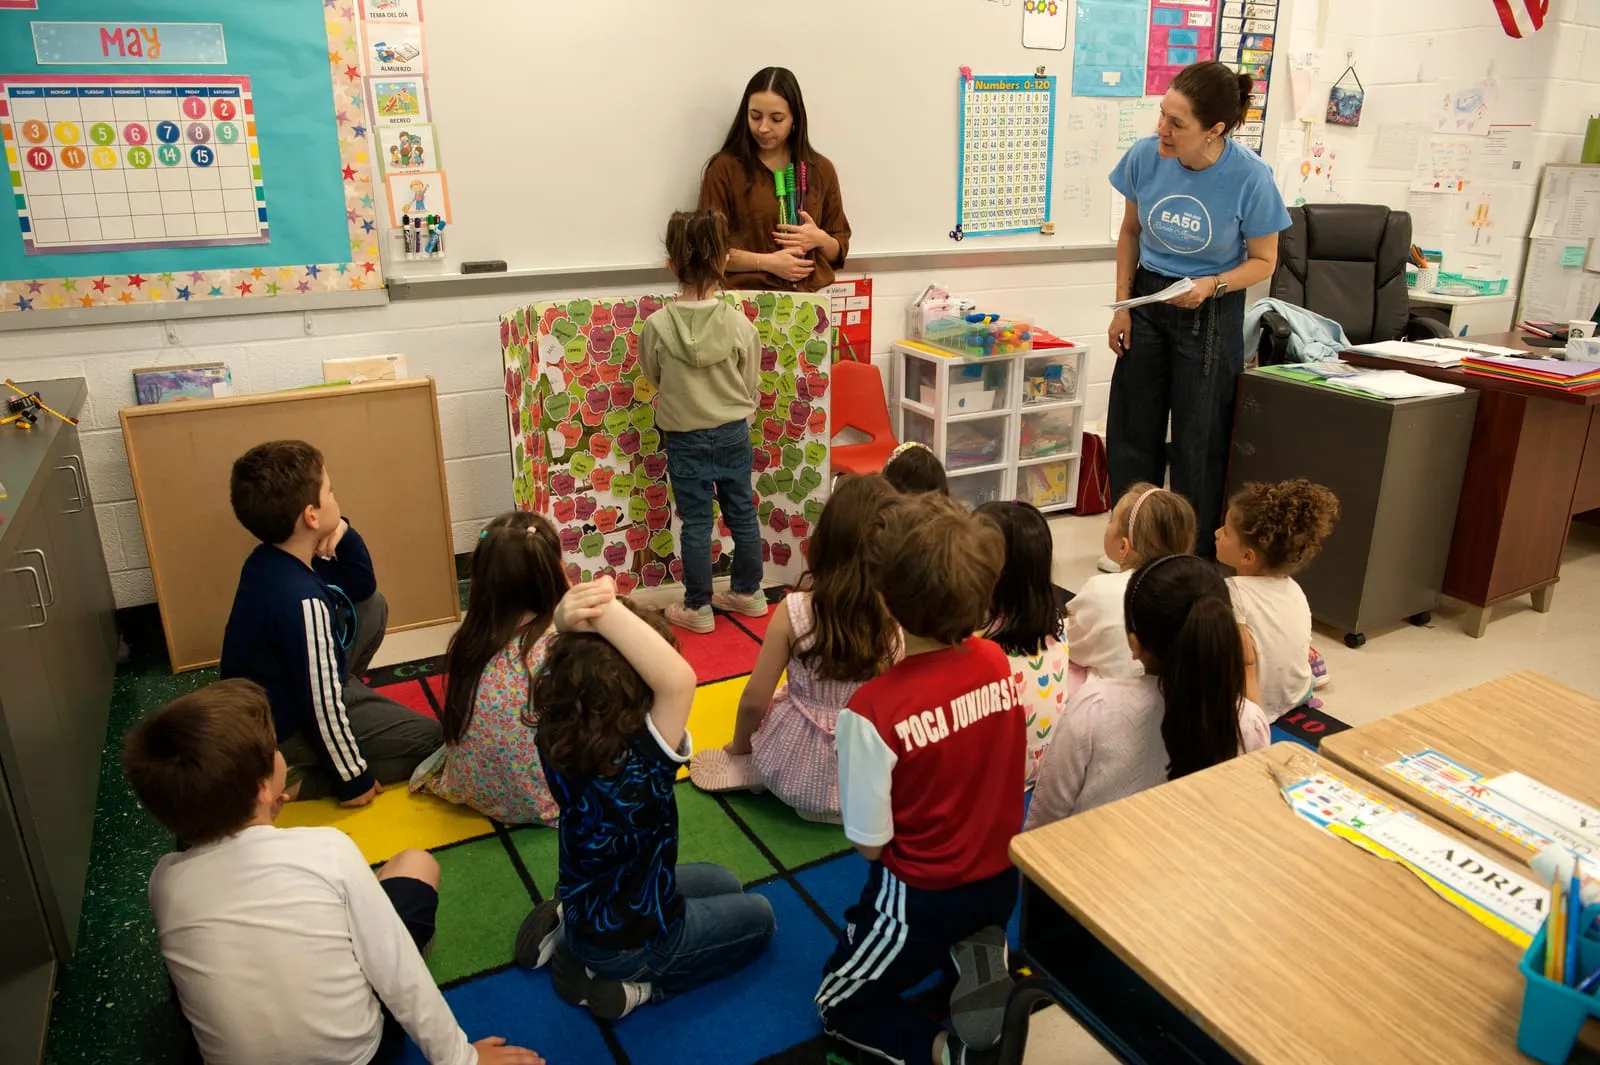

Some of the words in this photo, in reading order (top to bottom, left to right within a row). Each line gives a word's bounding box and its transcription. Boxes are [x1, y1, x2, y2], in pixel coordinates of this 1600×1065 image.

[100, 28, 161, 59] May
[975, 80, 1020, 90] Numbers
[1024, 80, 1050, 90] 0-120
[192, 102, 197, 115] 1
[220, 103, 229, 116] 2
[31, 124, 39, 138] 3
[98, 128, 107, 141] 5
[131, 128, 140, 141] 6
[164, 126, 172, 139] 7
[195, 126, 203, 140] 8
[224, 126, 232, 139] 9
[33, 152, 47, 166] 10
[67, 151, 79, 164] 11
[134, 151, 146, 165] 13
[163, 148, 176, 161] 14
[196, 150, 208, 163] 15
[894, 706, 950, 752] TOCA
